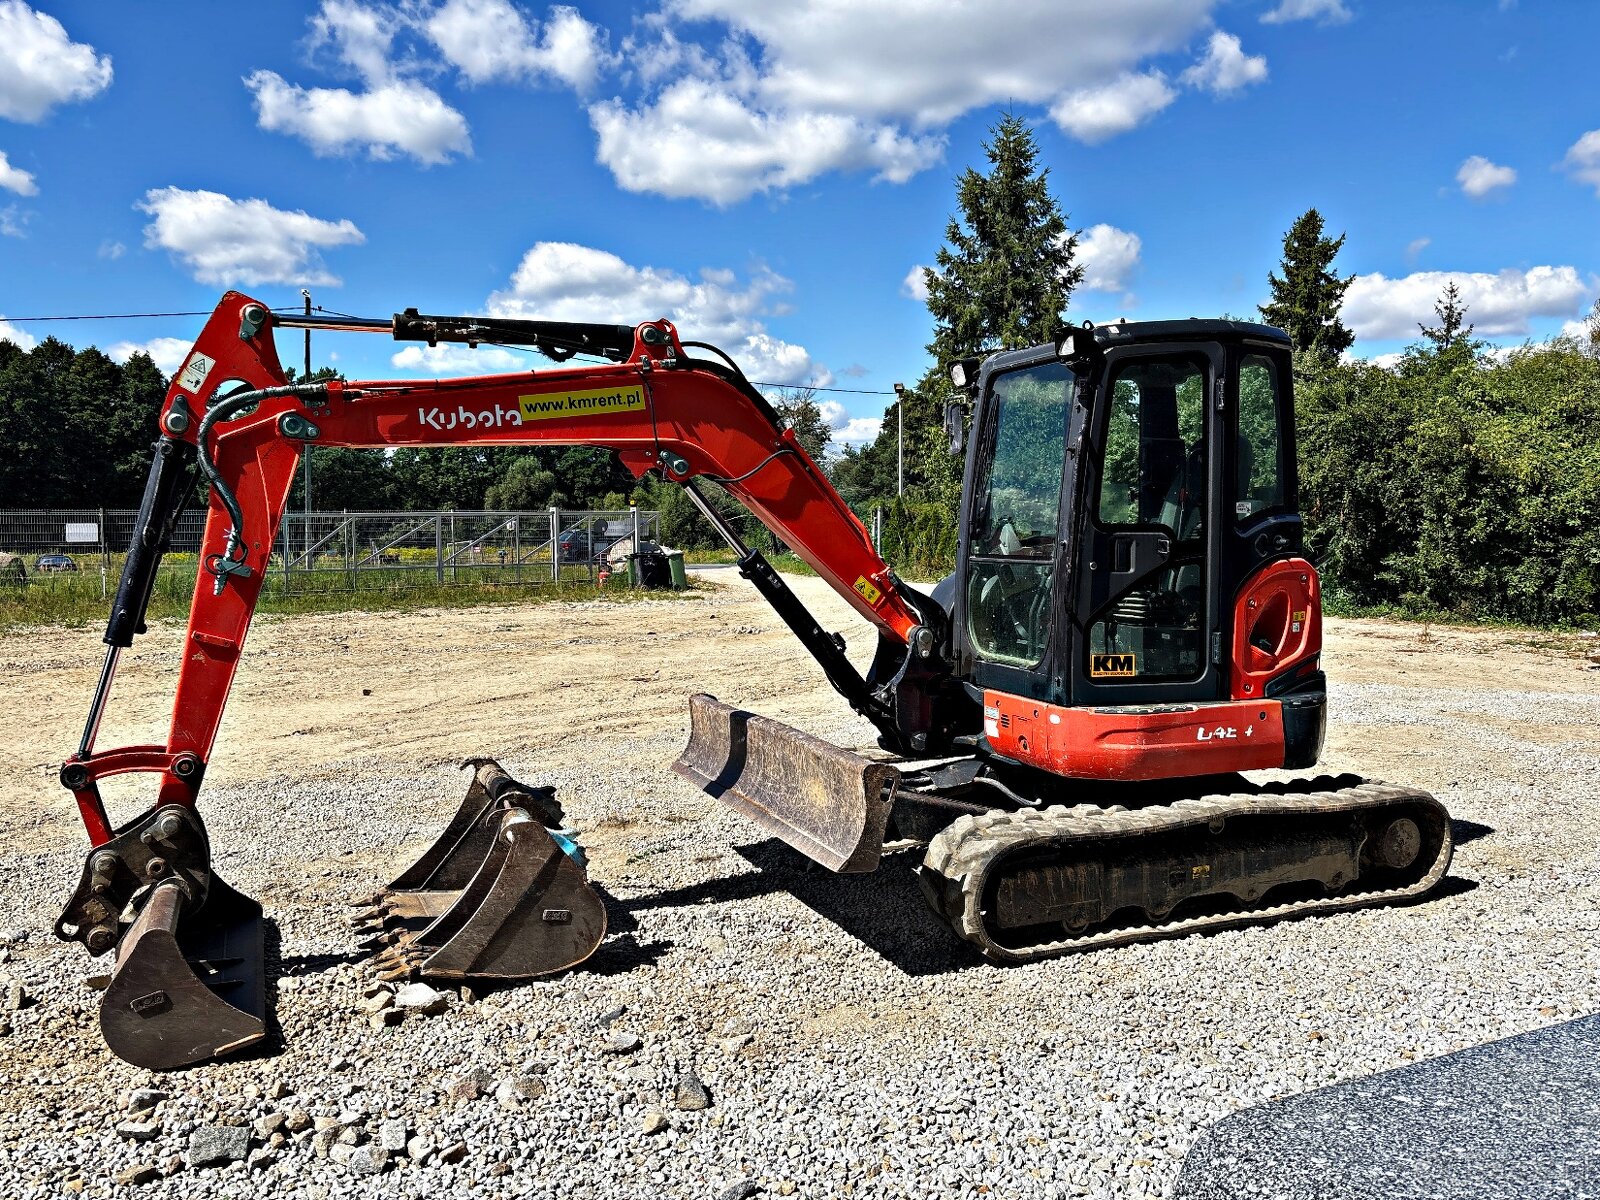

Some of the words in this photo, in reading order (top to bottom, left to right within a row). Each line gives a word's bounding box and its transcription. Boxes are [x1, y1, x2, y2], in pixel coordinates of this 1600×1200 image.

[524, 390, 641, 413] www.kmrent.pl
[418, 404, 522, 430] Kubota
[1093, 655, 1133, 671] KM
